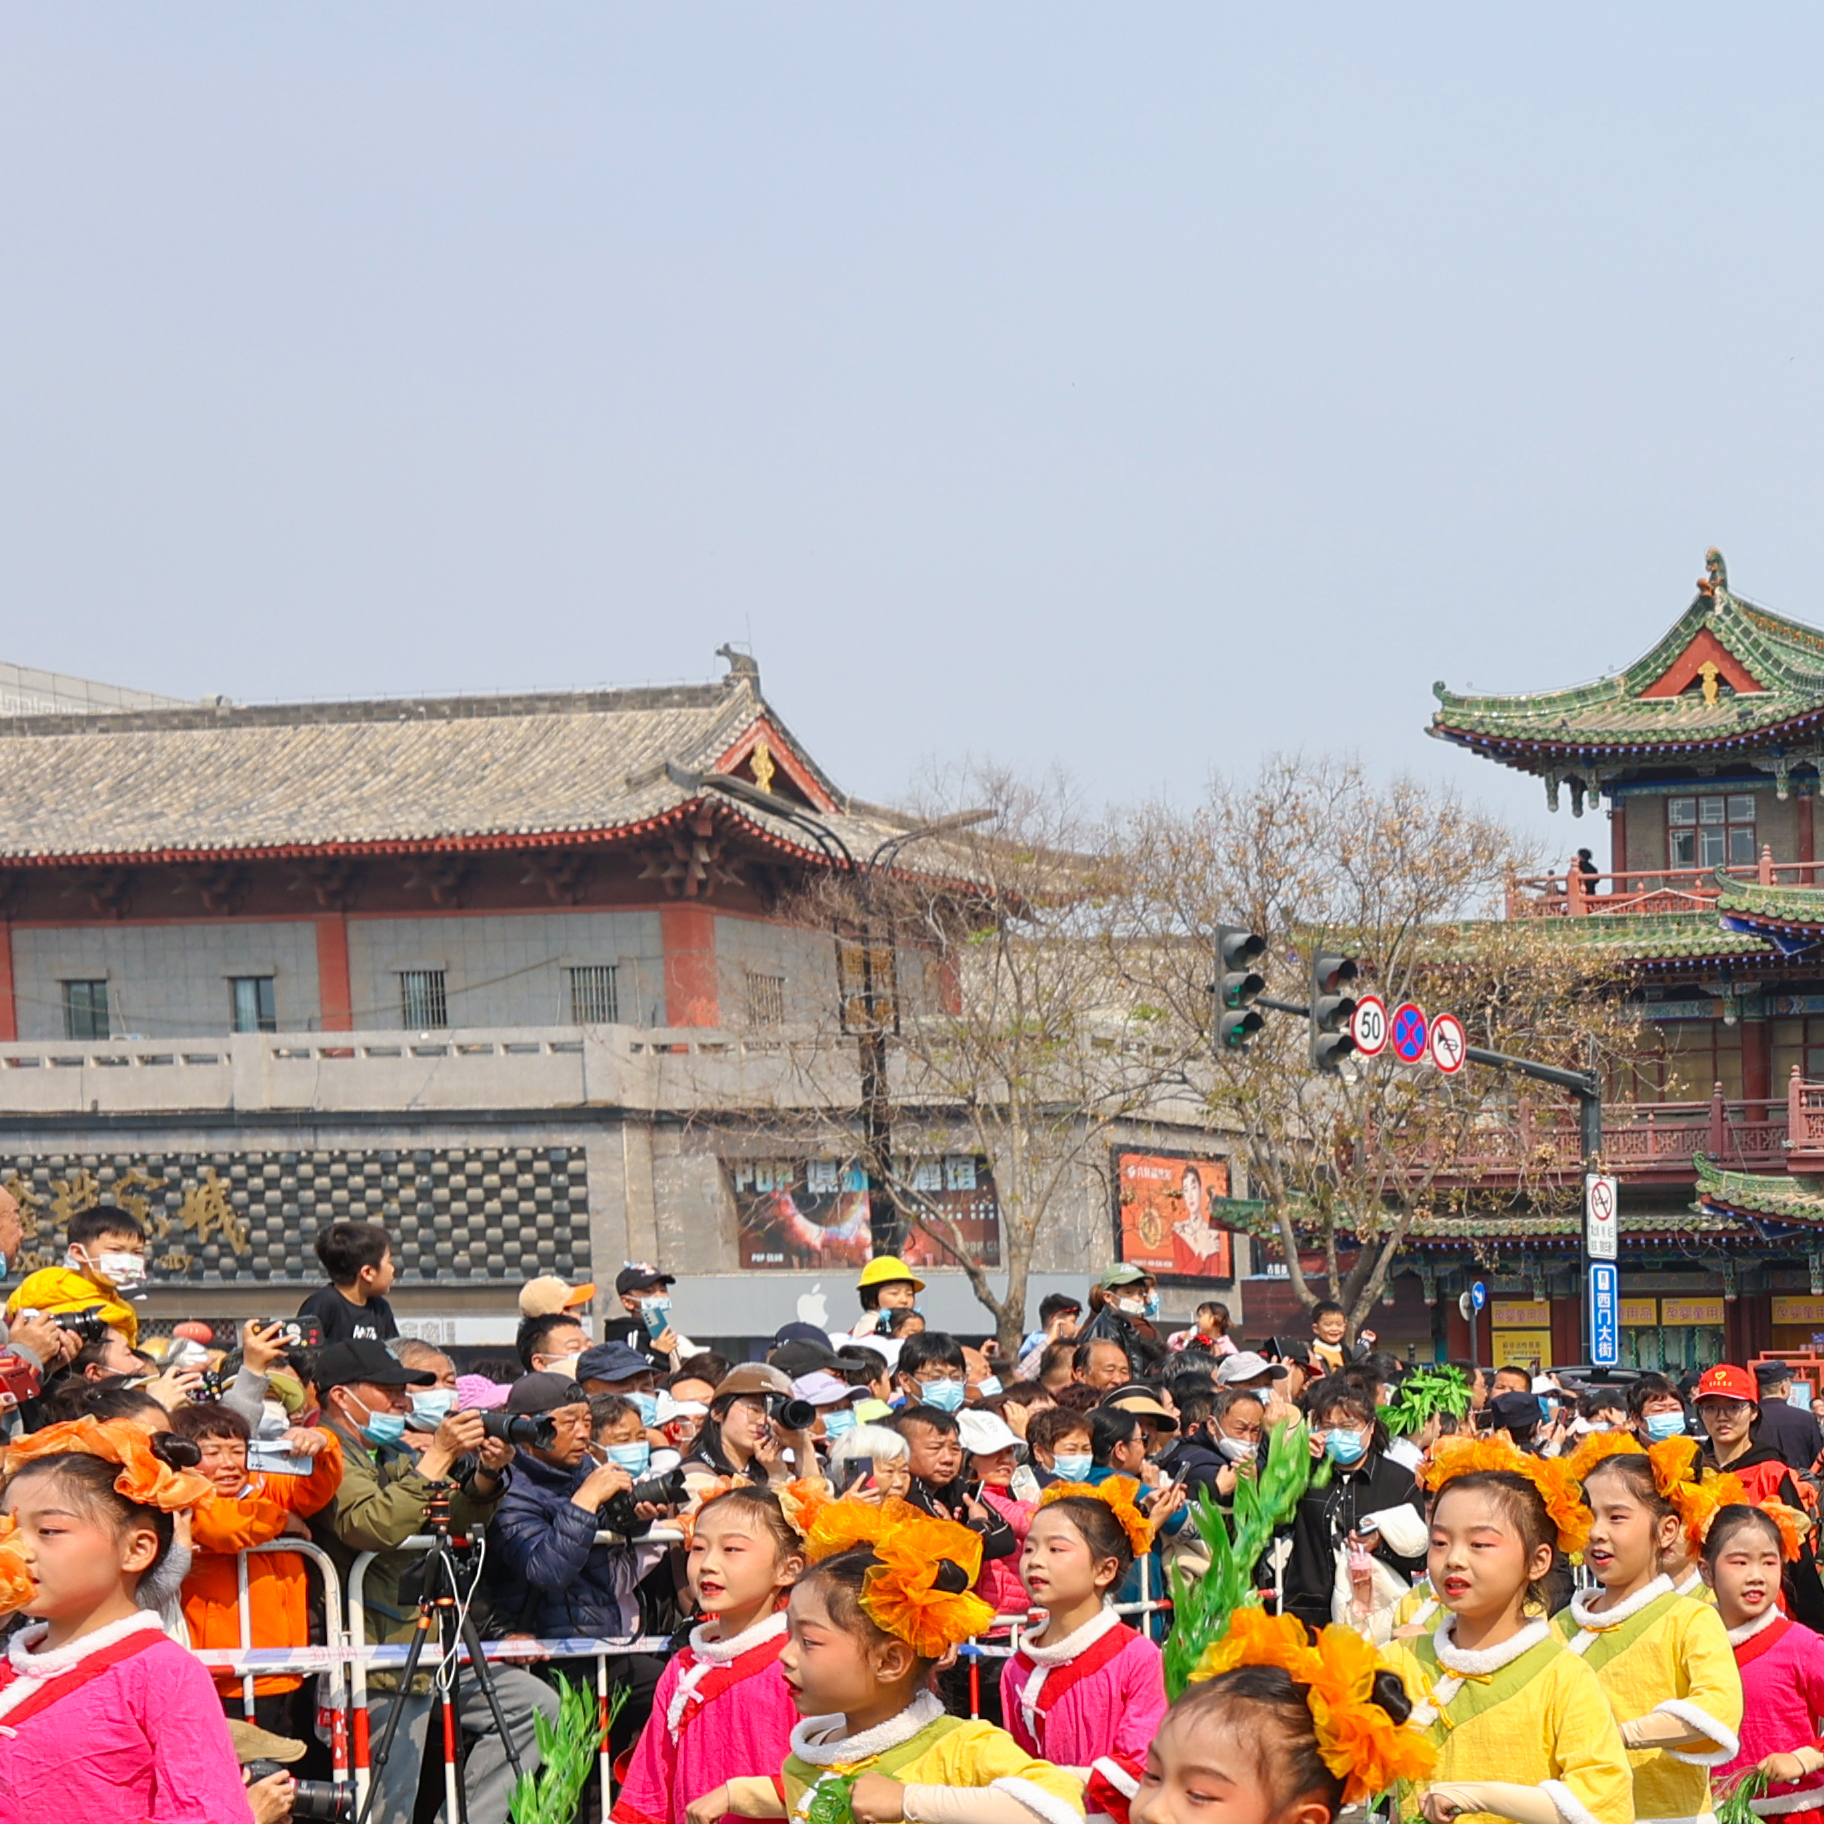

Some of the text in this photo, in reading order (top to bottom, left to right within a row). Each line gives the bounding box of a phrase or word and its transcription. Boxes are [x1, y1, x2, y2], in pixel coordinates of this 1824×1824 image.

[1361, 1011, 1380, 1040] 50
[751, 1253, 784, 1263] POP CLUB
[1597, 1293, 1612, 1359] 西门大街
